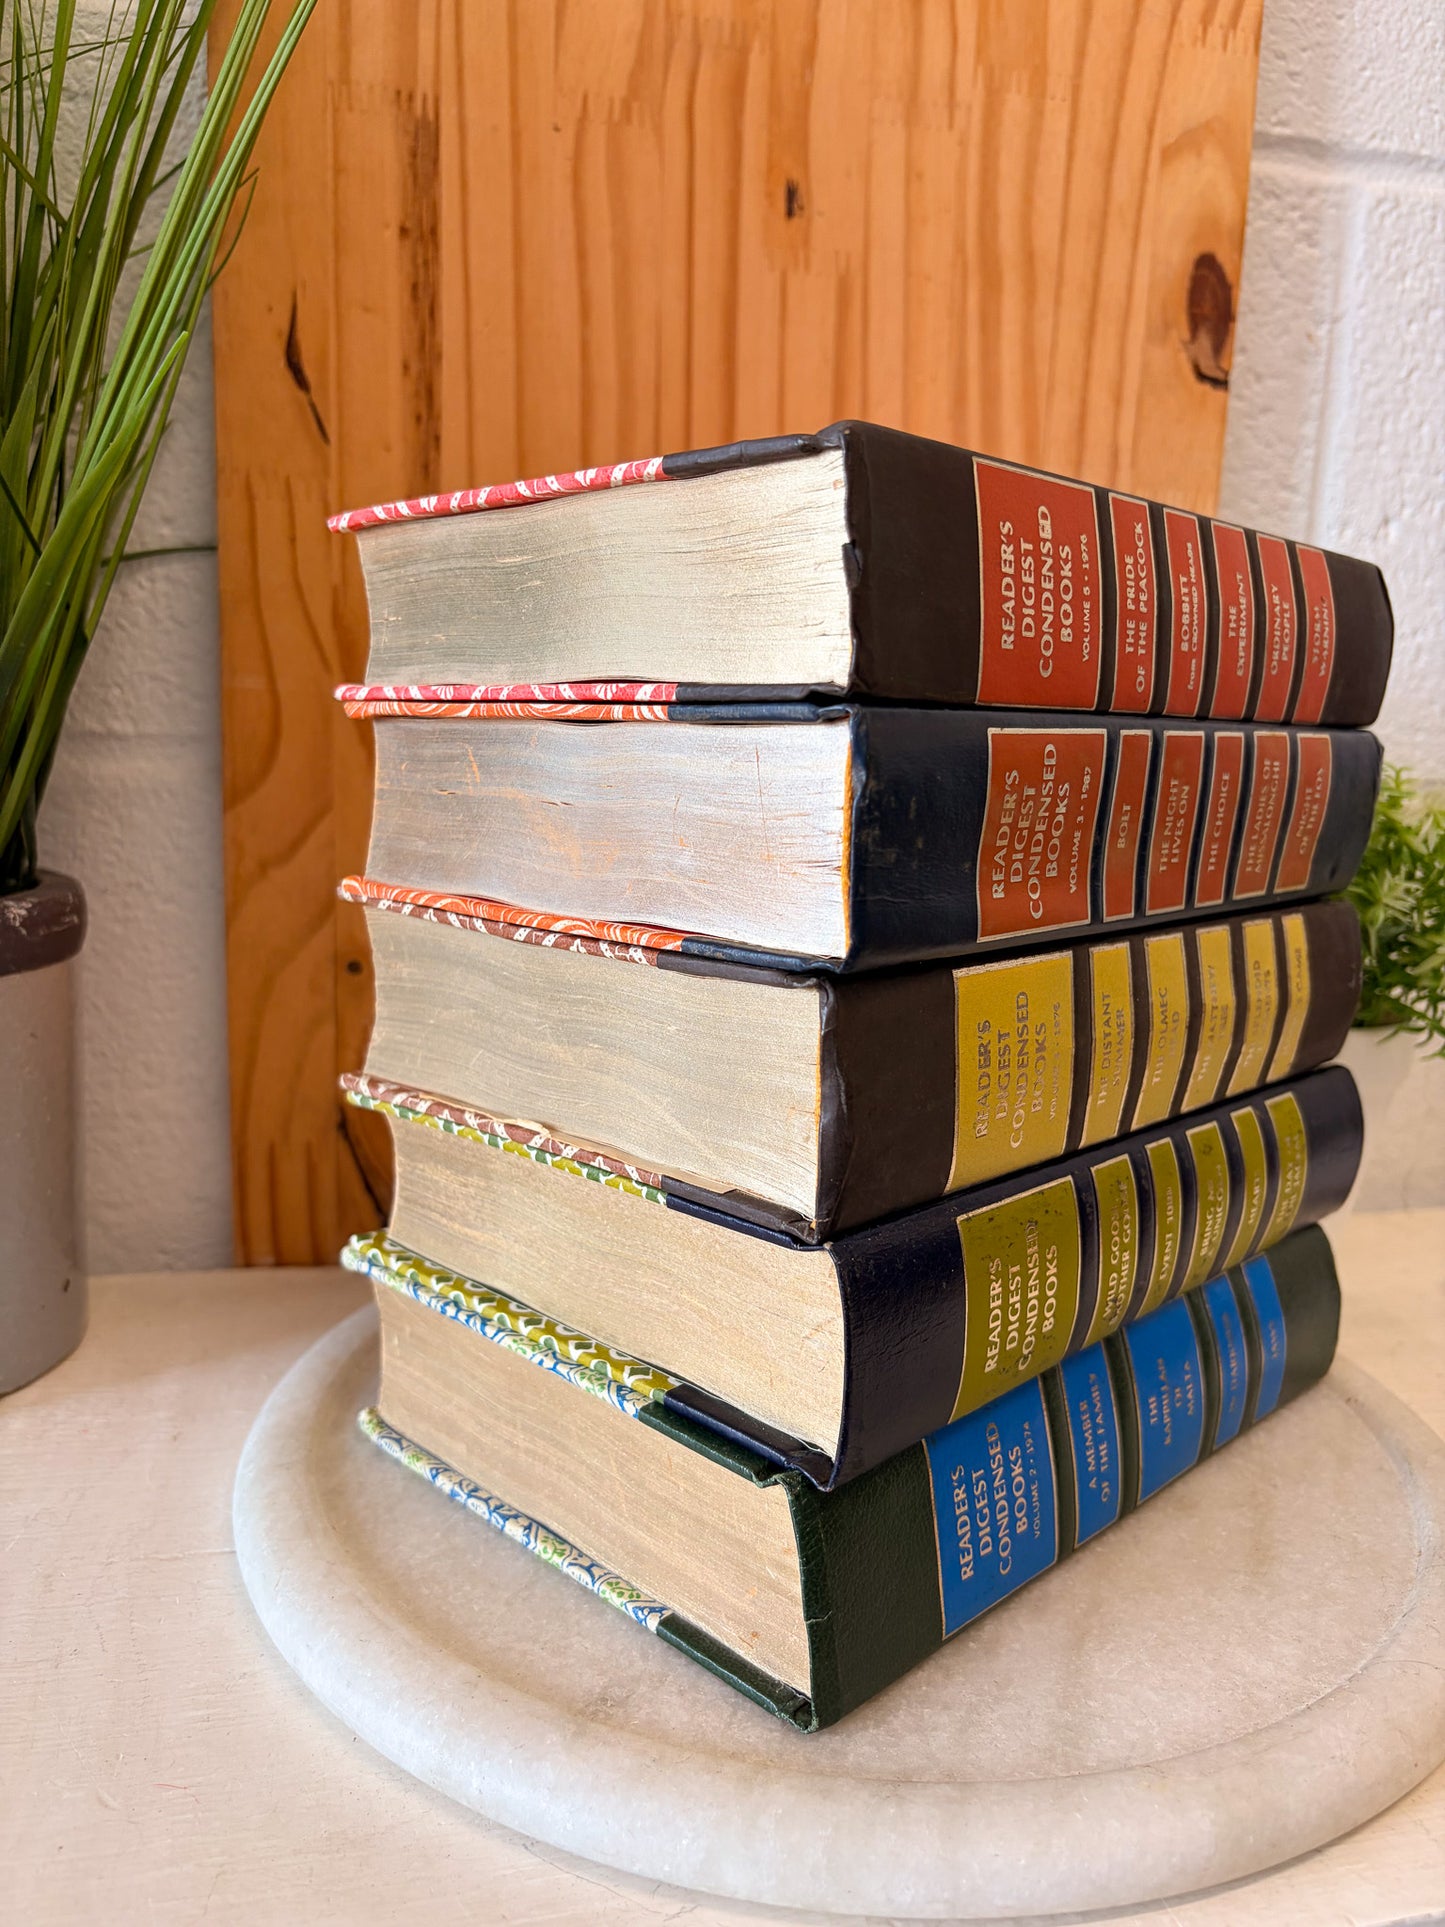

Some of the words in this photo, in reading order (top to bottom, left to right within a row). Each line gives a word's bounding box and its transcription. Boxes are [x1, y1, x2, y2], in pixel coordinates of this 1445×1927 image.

[1000, 520, 1015, 650] READER'S
[1020, 537, 1035, 638] DIGEST
[1080, 534, 1090, 569] 1976
[1125, 554, 1135, 610] PRIDE
[1134, 522, 1147, 613] PEACOCK
[1187, 542, 1197, 582] HEADS
[1038, 505, 1054, 678] CONDENSED
[1059, 544, 1073, 643] BOOKS
[1179, 574, 1189, 652] BOBBITT
[1190, 586, 1199, 652] CROWNED
[1228, 605, 1237, 638] THE
[1236, 571, 1246, 676] EXPERIMENT
[1270, 584, 1280, 675] ORDINARY
[1082, 601, 1091, 662] VOLUME
[1125, 620, 1134, 654] THE
[1138, 621, 1147, 656] THE
[1281, 601, 1290, 662] PEOPLE
[1136, 665, 1145, 693] OF
[1187, 658, 1197, 690] from
[1262, 758, 1271, 780] OF
[992, 769, 1018, 899] READER'S
[1011, 784, 1036, 882] DIGEST
[1027, 743, 1057, 919] CONDENSED
[1045, 782, 1070, 877] BOOKS
[1069, 830, 1081, 893] VOLUME
[1077, 817, 1084, 825] 3
[1081, 766, 1092, 800] 1987
[1117, 803, 1131, 849] BOLT
[1159, 841, 1169, 873] THE
[1164, 778, 1179, 836] NIGHT
[1171, 820, 1184, 863] LIVES
[1179, 785, 1190, 814] ON
[1208, 842, 1218, 872] THE
[1213, 771, 1230, 838] CHOICE
[1248, 786, 1270, 839] LADIES
[1245, 845, 1256, 872] THE
[1101, 992, 1112, 1069] DISTANT
[1151, 1055, 1164, 1085] THE
[1158, 987, 1168, 1049] OLMEC
[1207, 964, 1218, 1049] ATTHEW
[975, 1019, 992, 1139] READER'S
[995, 1029, 1011, 1120] DIGEST
[1010, 990, 1029, 1149] CONDENSED
[1031, 1022, 1047, 1113] BOOKS
[1112, 1008, 1125, 1087] SUMMER
[1097, 1077, 1108, 1105] THE
[1200, 1207, 1215, 1256] BRING
[1248, 1171, 1261, 1224] HEART
[1018, 1218, 1040, 1372] CONDENSED
[1042, 1244, 1057, 1332] BOOKS
[1102, 1272, 1118, 1318] WILD
[1159, 1233, 1173, 1280] EVENT
[984, 1257, 1002, 1374] READER'S
[1006, 1264, 1021, 1351] DIGEST
[1183, 1361, 1195, 1416] MALTA
[1222, 1312, 1238, 1391] DARKN
[1079, 1400, 1096, 1472] MEMBER
[1088, 1373, 1105, 1435] FAMILY
[1148, 1396, 1158, 1425] THE
[1009, 1445, 1027, 1533] BOOKS
[1089, 1477, 1097, 1489] A
[1098, 1441, 1109, 1472] THE
[1100, 1481, 1110, 1503] OF
[951, 1464, 973, 1580] READER'S
[972, 1468, 991, 1557] DIGEST
[985, 1421, 1012, 1575] CONDENSED
[1030, 1480, 1041, 1539] VOLUME
